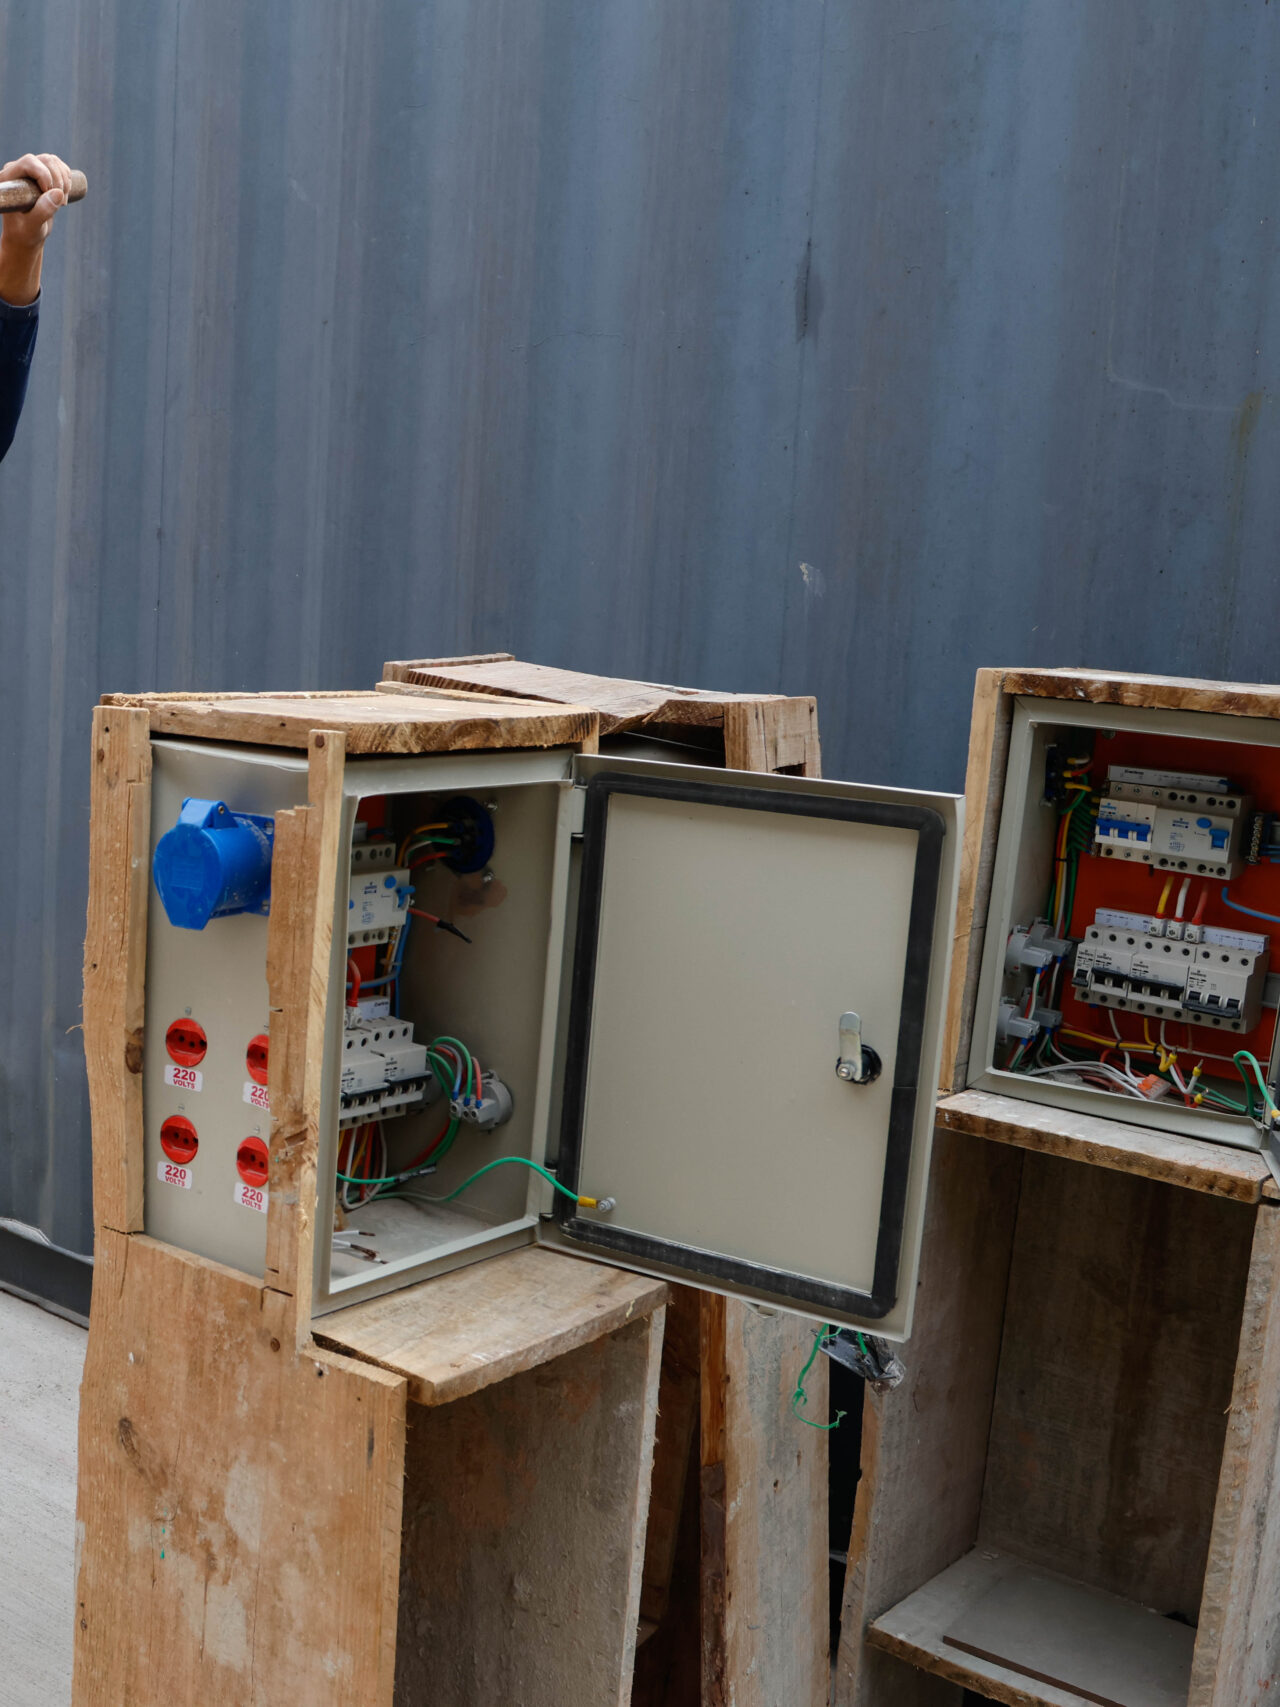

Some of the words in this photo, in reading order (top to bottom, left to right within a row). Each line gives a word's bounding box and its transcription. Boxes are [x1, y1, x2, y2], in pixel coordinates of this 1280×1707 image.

[173, 1068, 196, 1082] 220
[173, 1078, 195, 1089] VOLTS
[165, 1165, 186, 1180] 220
[165, 1175, 185, 1186] VOLTS
[242, 1187, 263, 1203] 220
[241, 1197, 262, 1210] VOLTS
